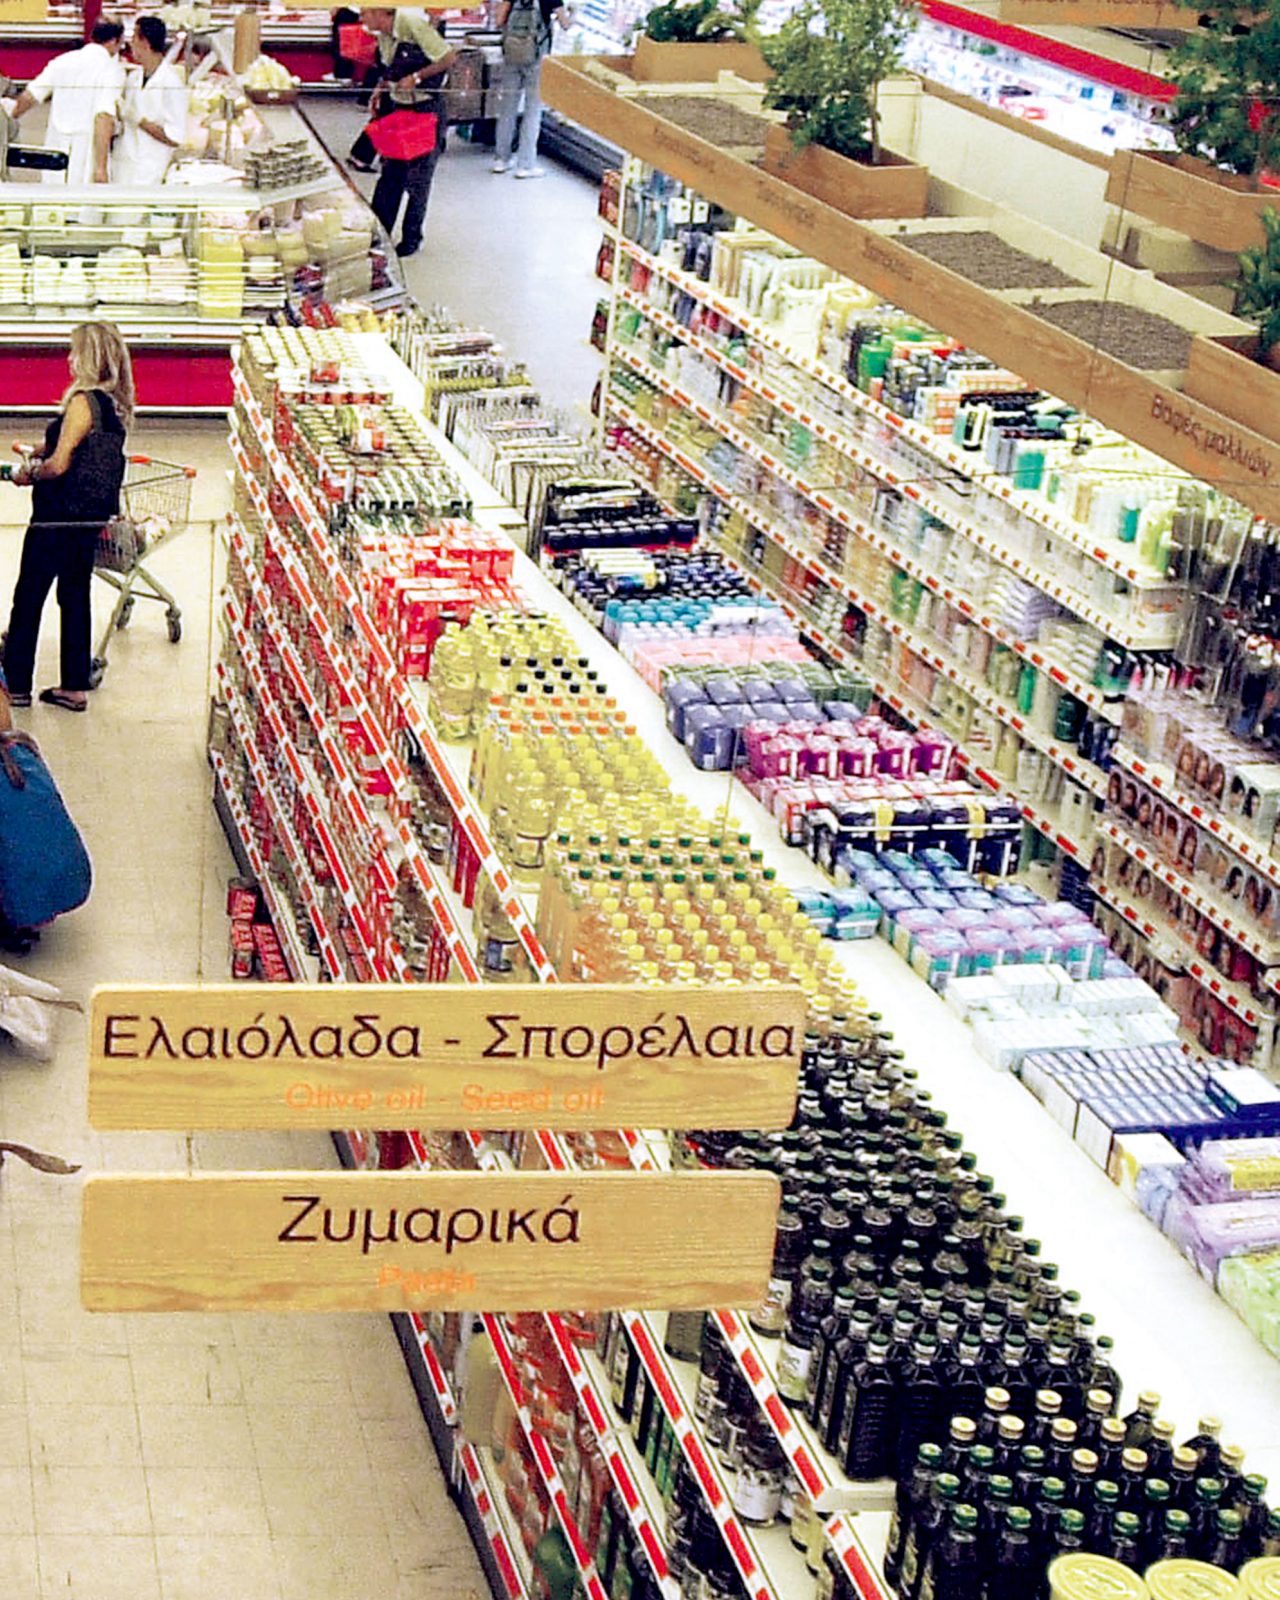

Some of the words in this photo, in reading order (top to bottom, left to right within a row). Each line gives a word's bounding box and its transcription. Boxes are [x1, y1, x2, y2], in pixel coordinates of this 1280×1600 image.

[104, 1012, 422, 1060] Ελαιόλαδα
[482, 1012, 796, 1070] Σπορέλαια
[285, 1082, 373, 1111] Olive
[386, 1084, 426, 1112] oil
[461, 1083, 552, 1113] Seed
[563, 1084, 606, 1113] oil
[277, 1194, 580, 1254] Ζυμαρικά
